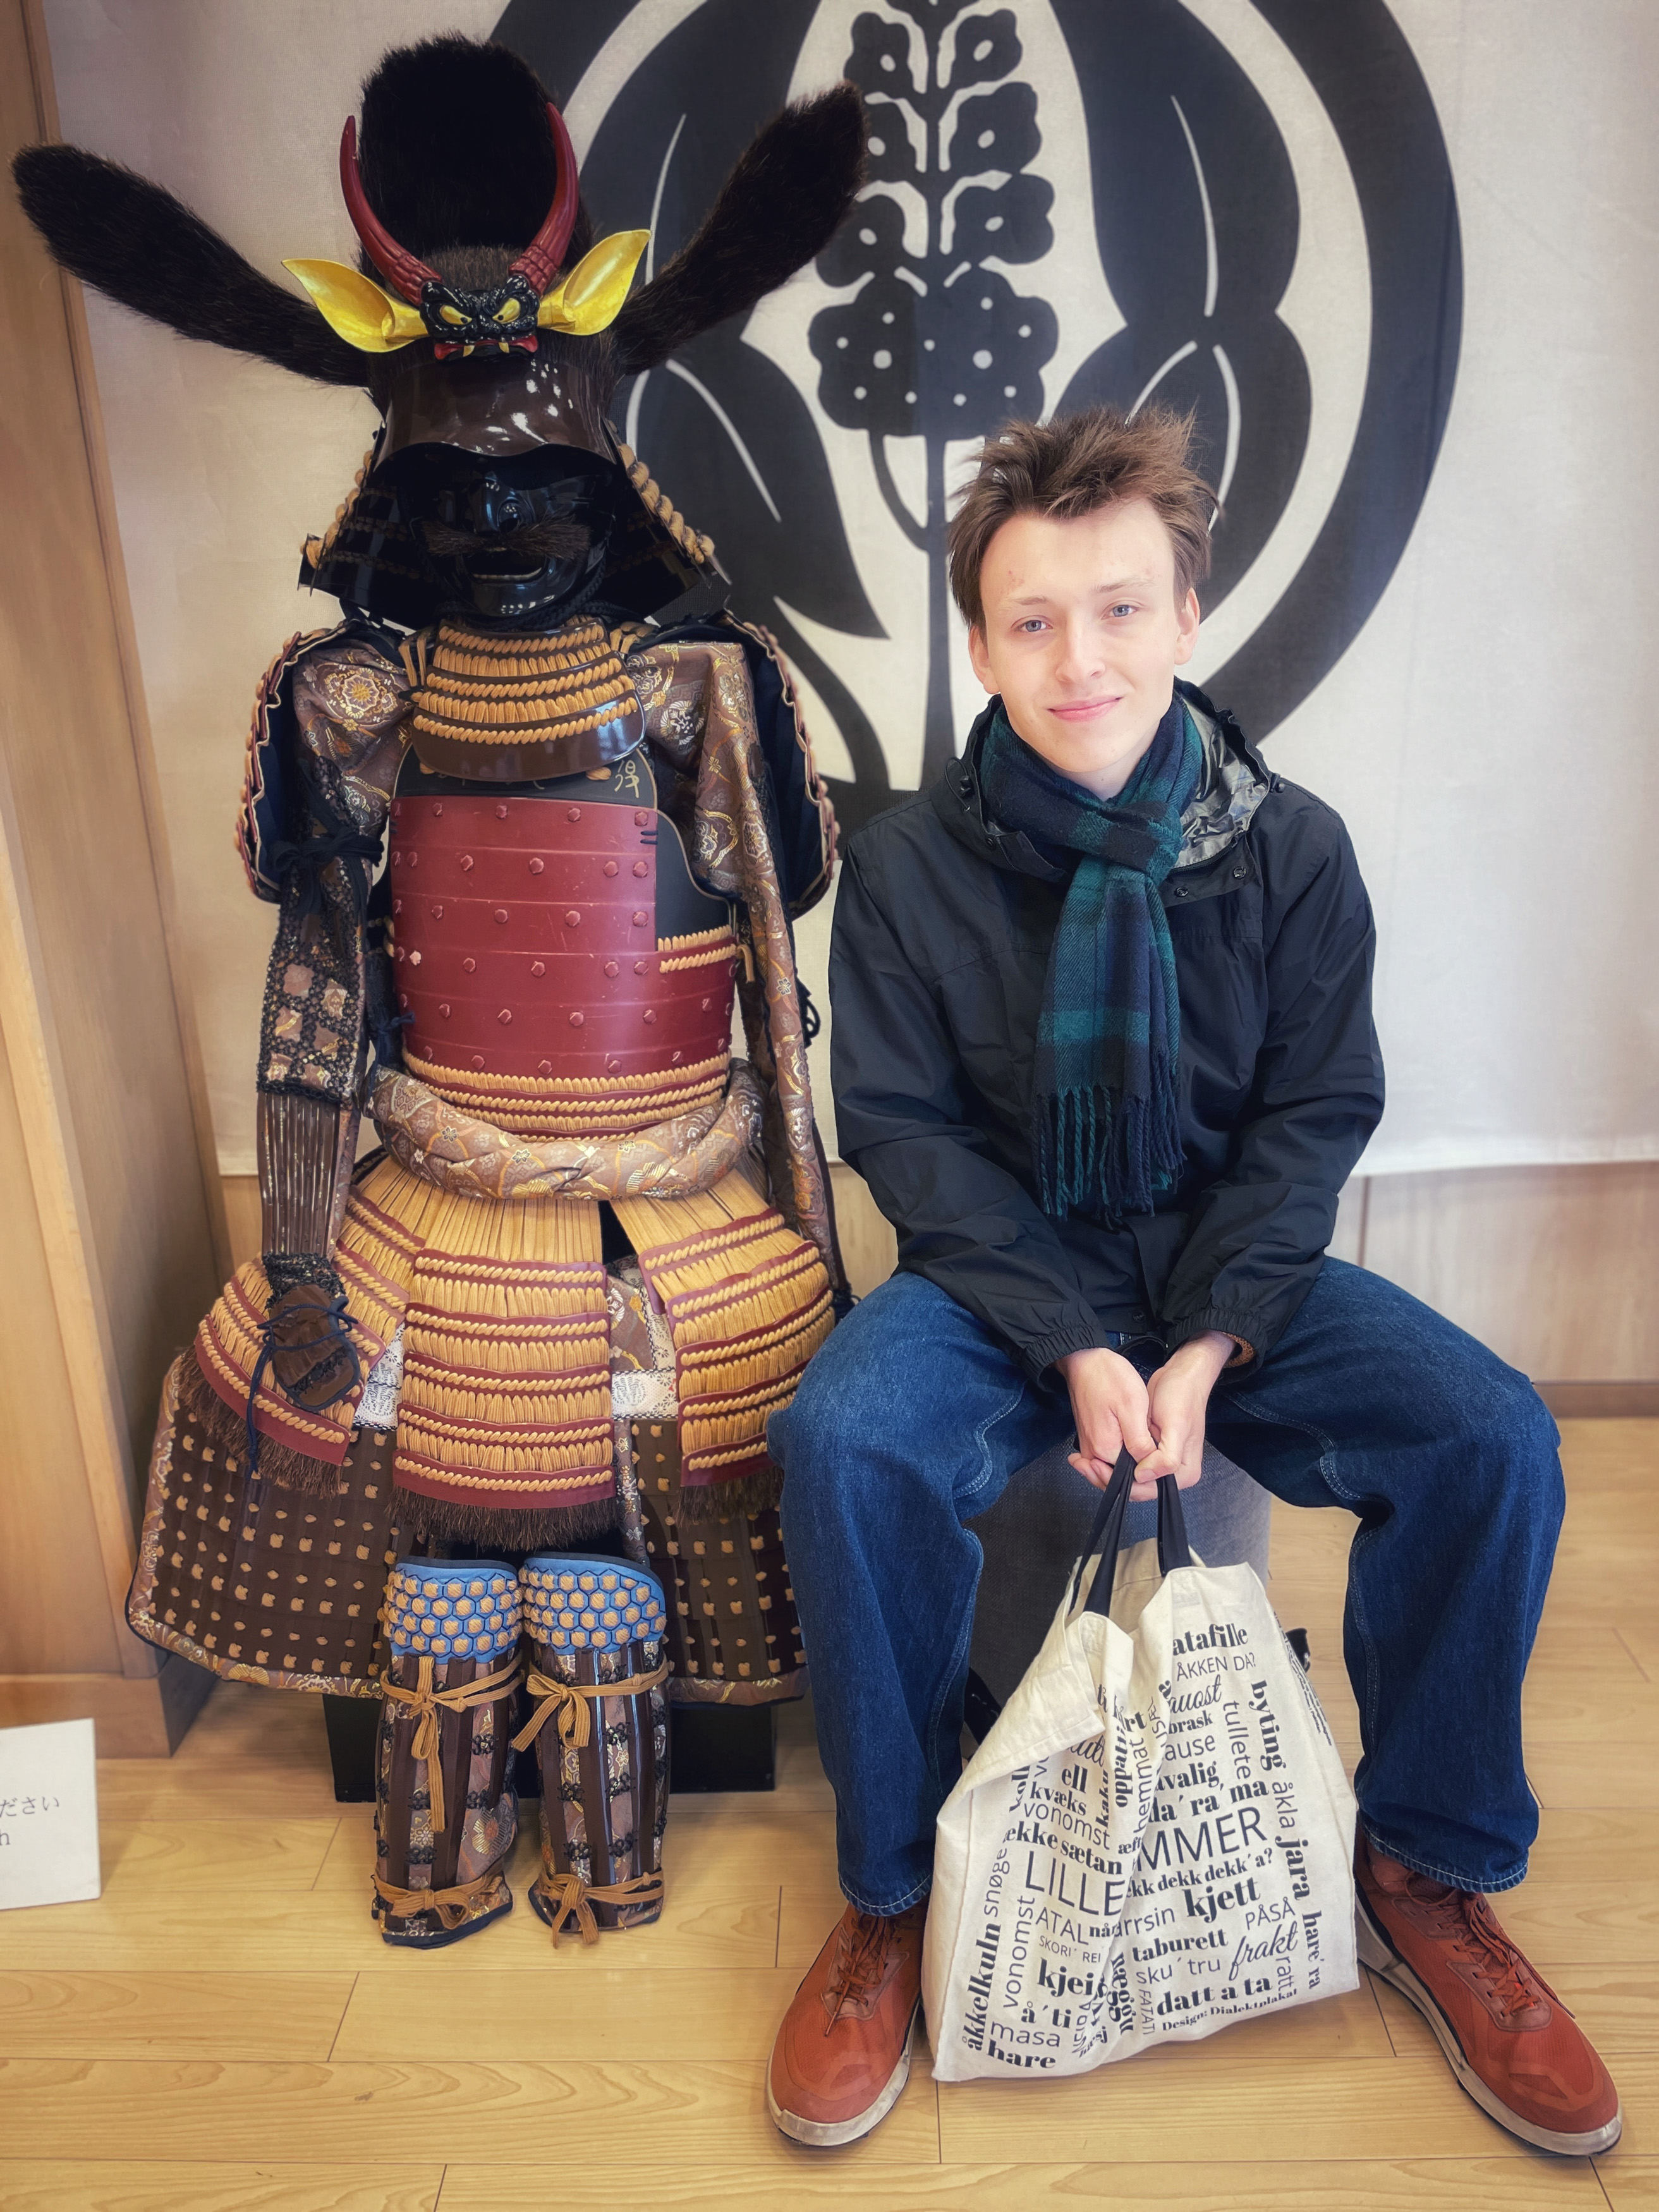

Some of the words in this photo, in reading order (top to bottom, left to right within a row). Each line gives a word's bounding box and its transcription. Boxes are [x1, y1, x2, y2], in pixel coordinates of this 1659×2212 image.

[1176, 1655, 1228, 1682] ÅKKEN
[1233, 1651, 1256, 1671] DA?
[1223, 1700, 1251, 1780] tullete
[1249, 1679, 1287, 1770] byting
[1029, 1781, 1086, 1816] kvæks
[1061, 1763, 1088, 1794] ell
[1129, 1737, 1153, 1833] hemmat
[1023, 1802, 1110, 1850] vonomst
[1272, 1782, 1298, 1828] åkla
[1060, 1840, 1122, 1875] sætan
[1275, 1835, 1310, 1901] jara
[983, 1847, 1010, 1918] snøge
[1157, 1869, 1203, 1892] dekk
[1181, 1876, 1261, 1923] kjett
[1035, 1906, 1090, 1946] ATAL
[1245, 1896, 1296, 1931] PÅSÅ
[1003, 1895, 1035, 2008] vonomst
[1132, 1928, 1229, 1962] taburett
[1228, 1920, 1299, 1981] frakt
[961, 1923, 1002, 2051] åkkelkuln
[1275, 1955, 1295, 1992] ratt
[1156, 1986, 1215, 2016] datt
[1220, 1985, 1239, 2001] a
[1244, 1977, 1273, 1996] ta
[1162, 2010, 1208, 2032] Design:
[1210, 1988, 1297, 2016] Dialektplakat
[986, 2038, 1057, 2069] hare
[990, 2021, 1061, 2048] masa
